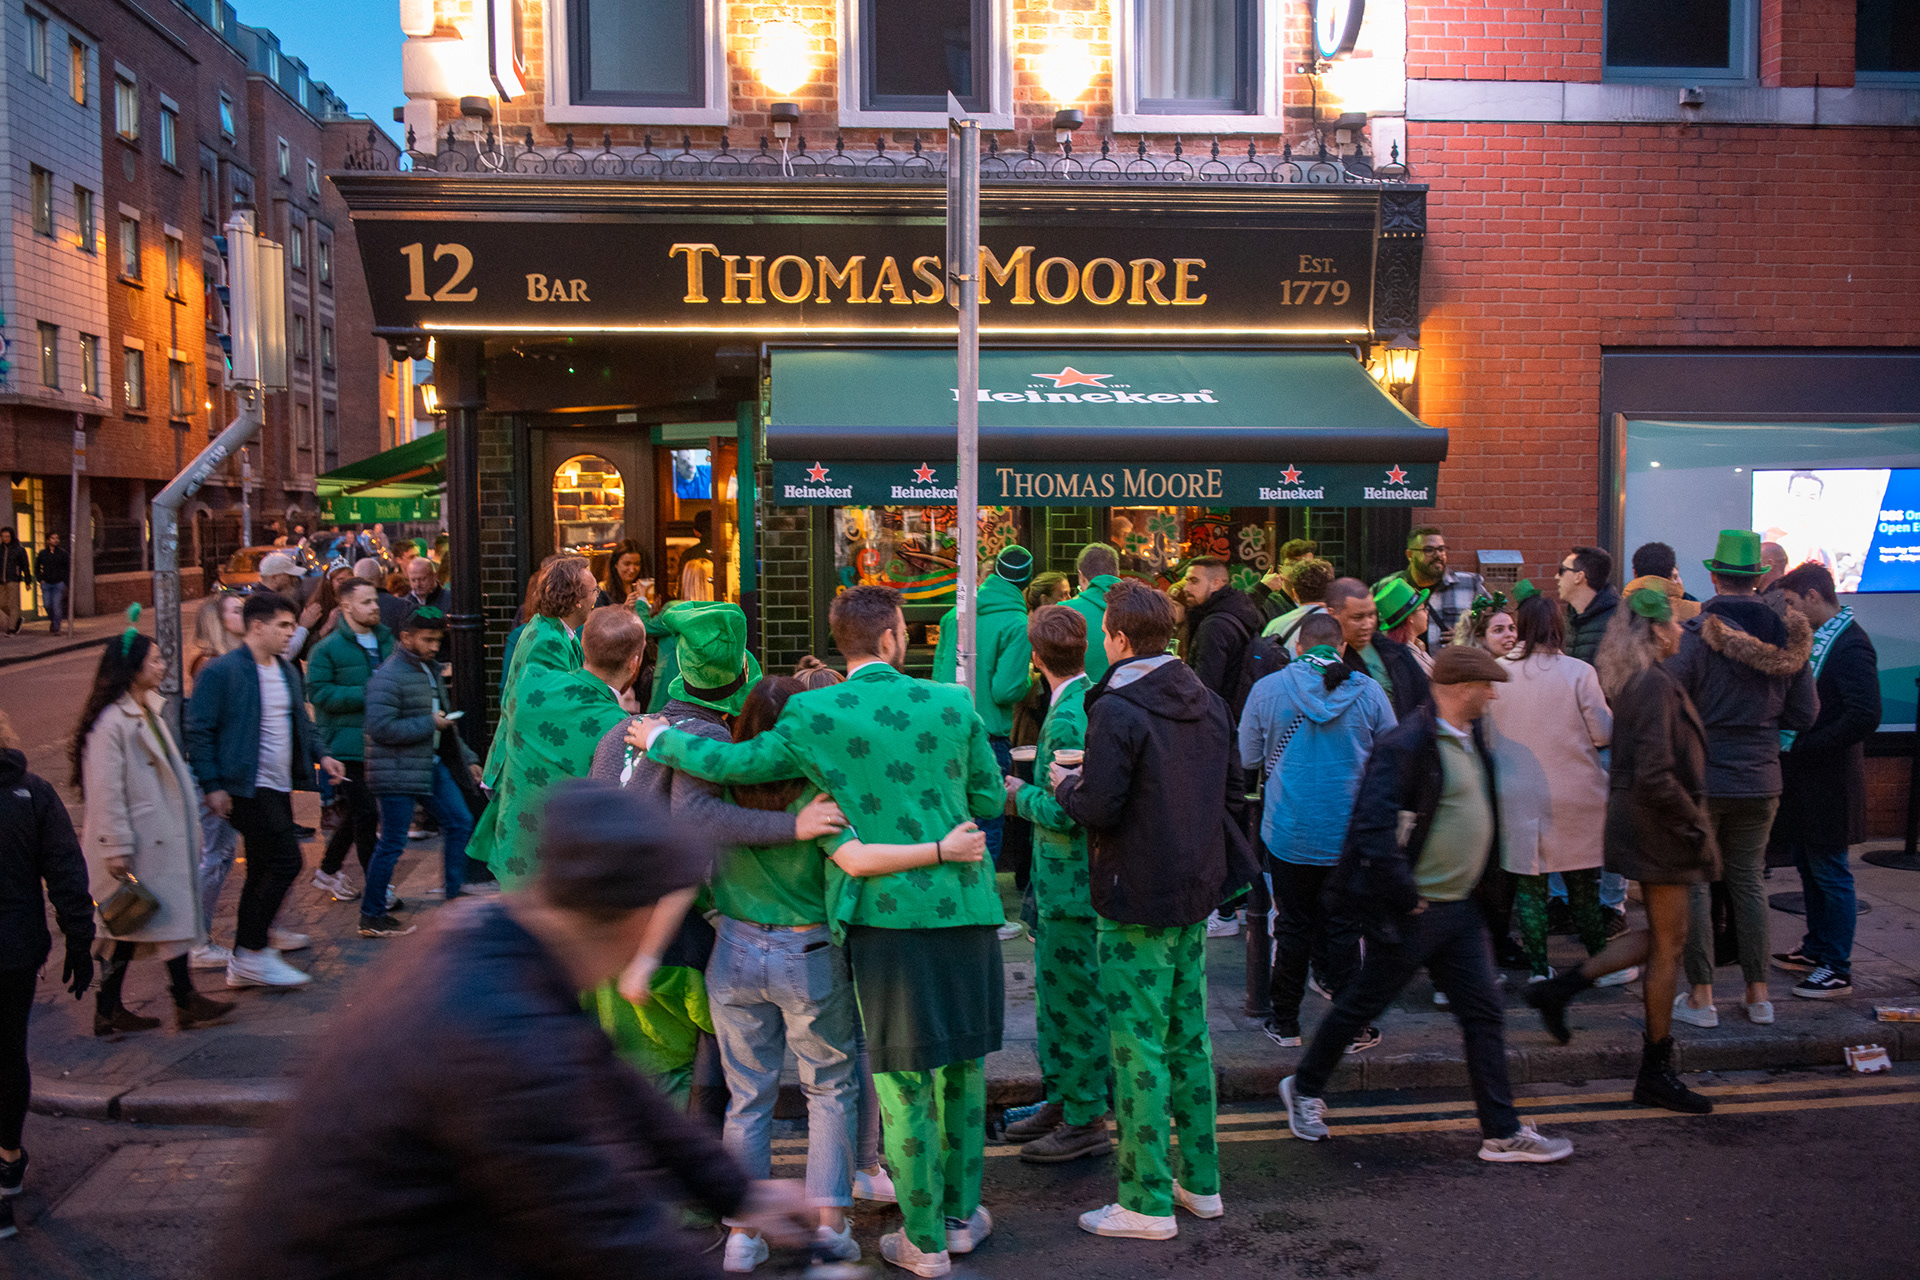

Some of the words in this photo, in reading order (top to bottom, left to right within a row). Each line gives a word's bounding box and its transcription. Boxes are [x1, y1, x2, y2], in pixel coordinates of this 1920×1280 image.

[400, 242, 478, 302] 12
[1298, 254, 1338, 273] EST.
[668, 243, 945, 304] THOMAS
[977, 245, 1208, 305] MOORE
[525, 273, 591, 302] BAR
[1280, 279, 1351, 305] 1779
[784, 484, 853, 498] Heineken
[890, 485, 958, 499] Heineken
[995, 468, 1115, 498] THOMAS
[1122, 468, 1223, 498] MOORE
[1258, 486, 1325, 500] Heineken
[1363, 487, 1429, 500] Heineken
[1878, 523, 1911, 536] Open
